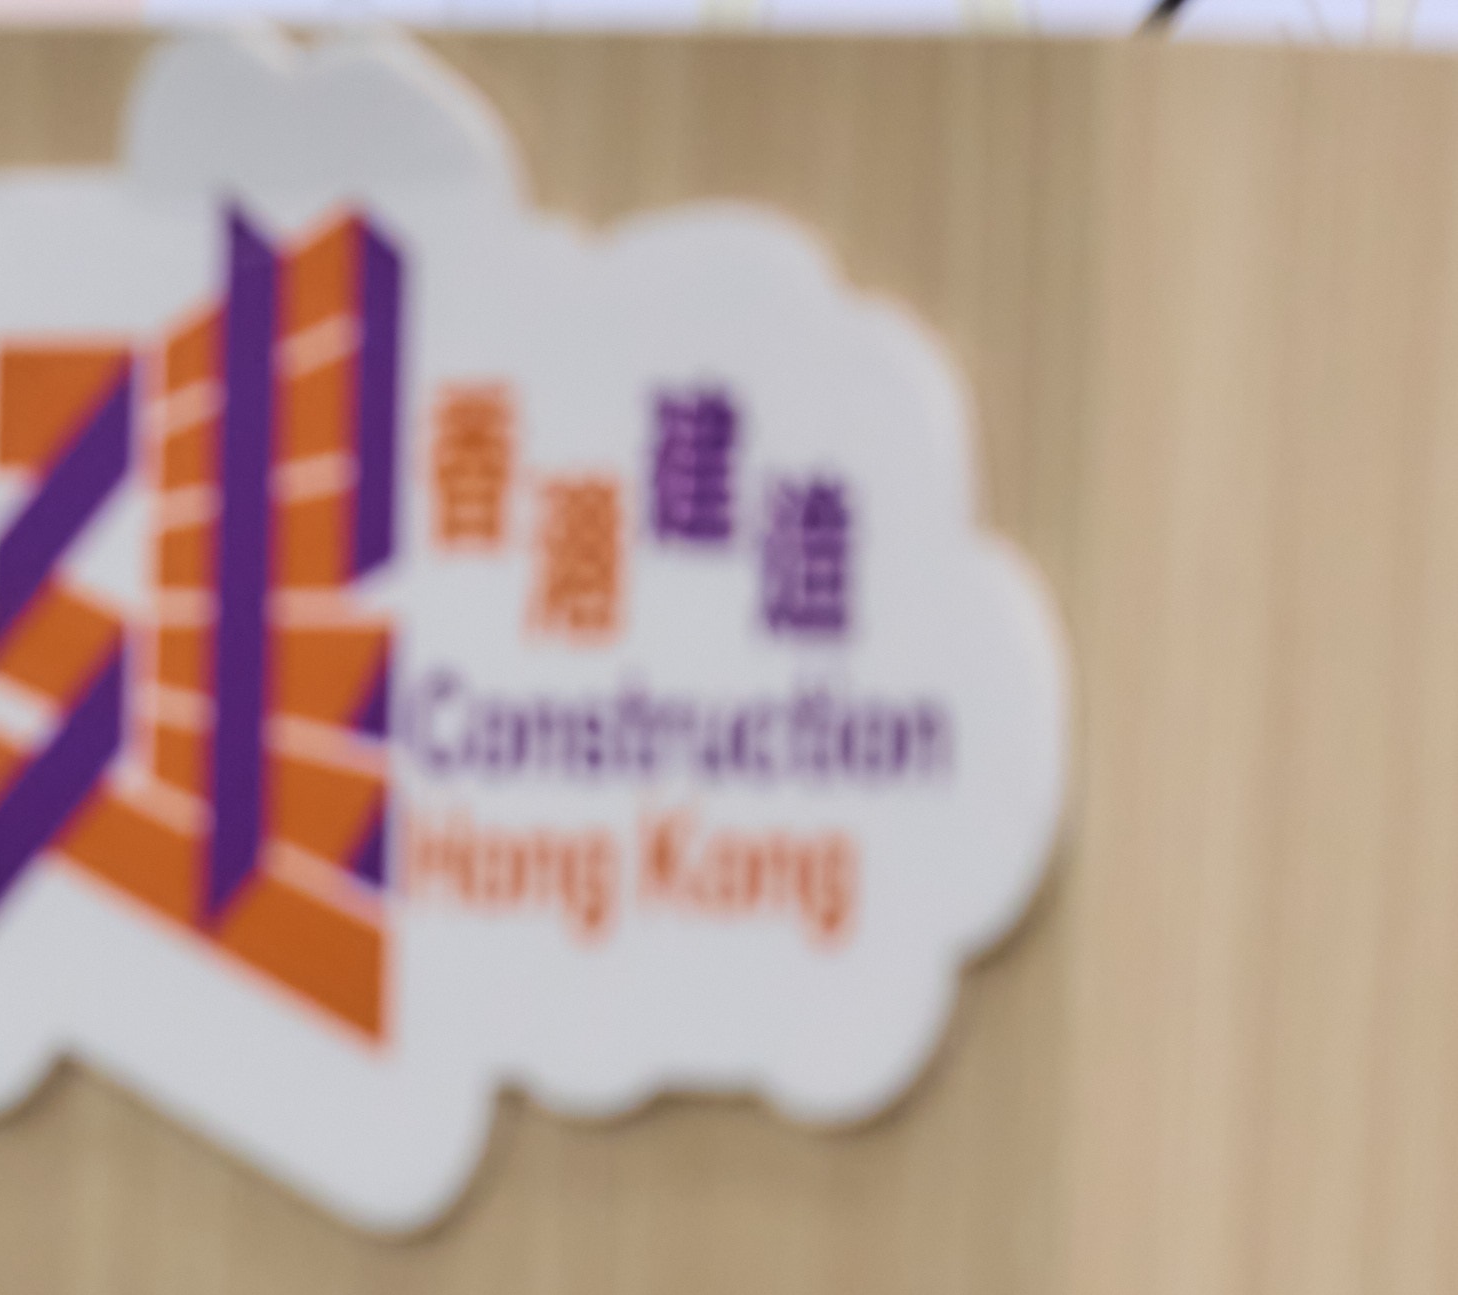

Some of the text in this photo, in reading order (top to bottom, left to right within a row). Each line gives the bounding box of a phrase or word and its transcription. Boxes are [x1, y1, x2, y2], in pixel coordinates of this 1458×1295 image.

[408, 668, 956, 787] Construction
[410, 806, 856, 952] Hong Kong
